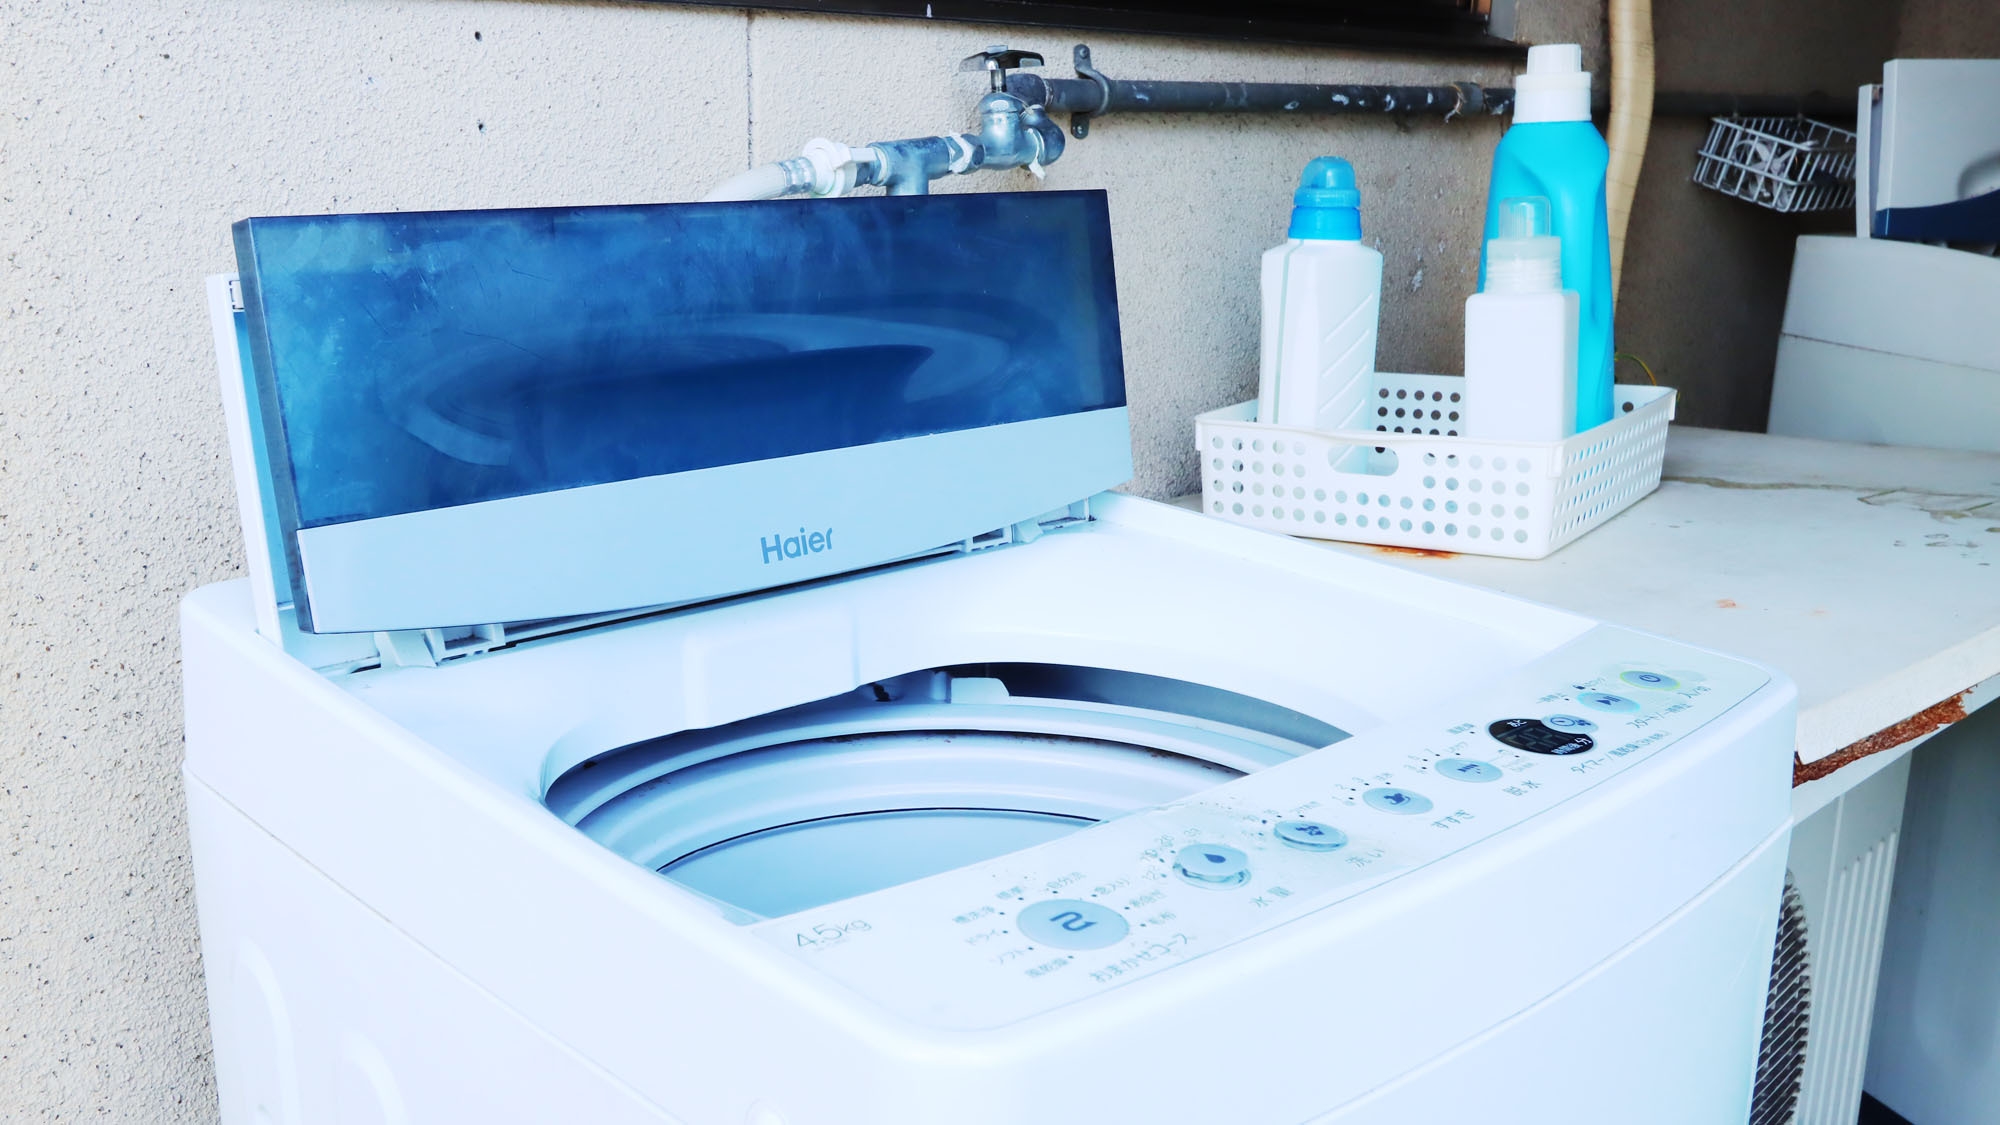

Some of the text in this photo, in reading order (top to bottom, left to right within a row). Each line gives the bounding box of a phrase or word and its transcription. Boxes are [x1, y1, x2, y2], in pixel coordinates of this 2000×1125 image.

[761, 527, 832, 564] Haier
[1507, 718, 1527, 727] あと
[1432, 810, 1474, 828] すすぎ
[797, 919, 872, 947] 4.5kg
[1090, 933, 1193, 982] おまかせコース
